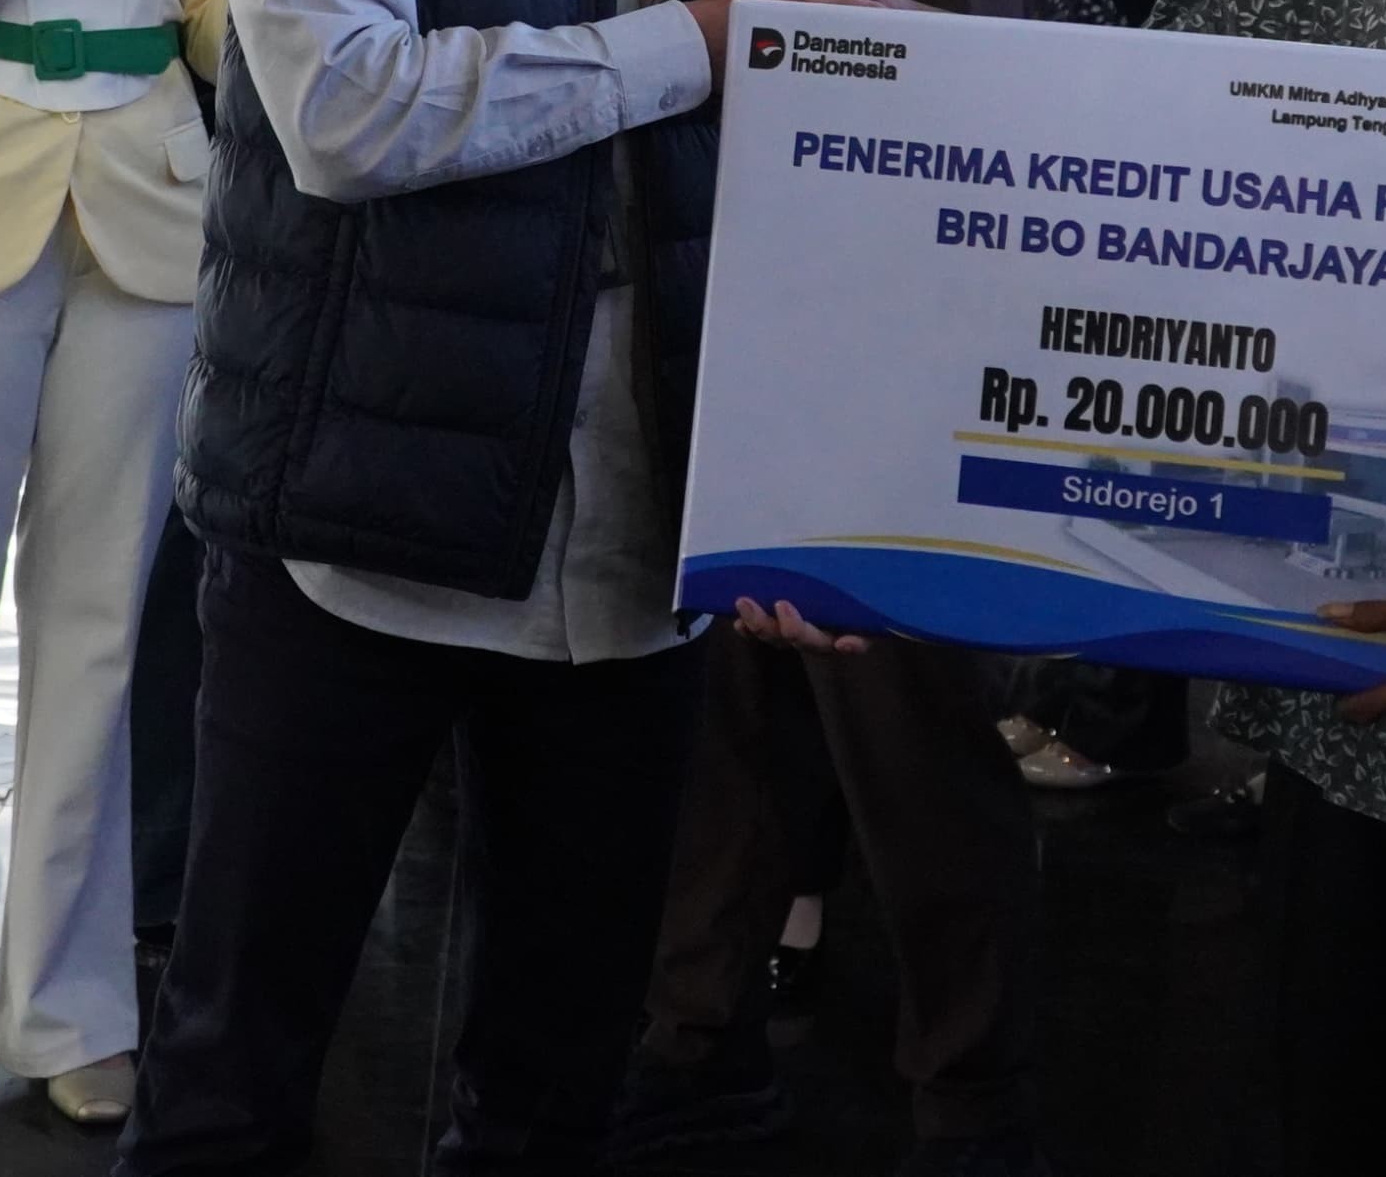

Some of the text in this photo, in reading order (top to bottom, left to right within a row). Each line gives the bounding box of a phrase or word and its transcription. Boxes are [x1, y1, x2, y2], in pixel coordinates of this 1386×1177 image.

[791, 52, 898, 80] Indonesia
[793, 30, 907, 59] Danantara
[1230, 81, 1284, 100] UMKM
[1288, 86, 1331, 104] Mitra
[1271, 109, 1348, 132] Lampung
[792, 131, 1016, 188] PENERIMA
[1027, 153, 1191, 202] KREDIT
[1201, 168, 1362, 220] USAHA
[936, 208, 1009, 250] BRI
[1021, 216, 1086, 257] BO
[1039, 305, 1276, 373] HENDRIYANTO
[979, 366, 1330, 458] Rp. 20.000.000
[1063, 475, 1225, 521] Sidorejo 1
